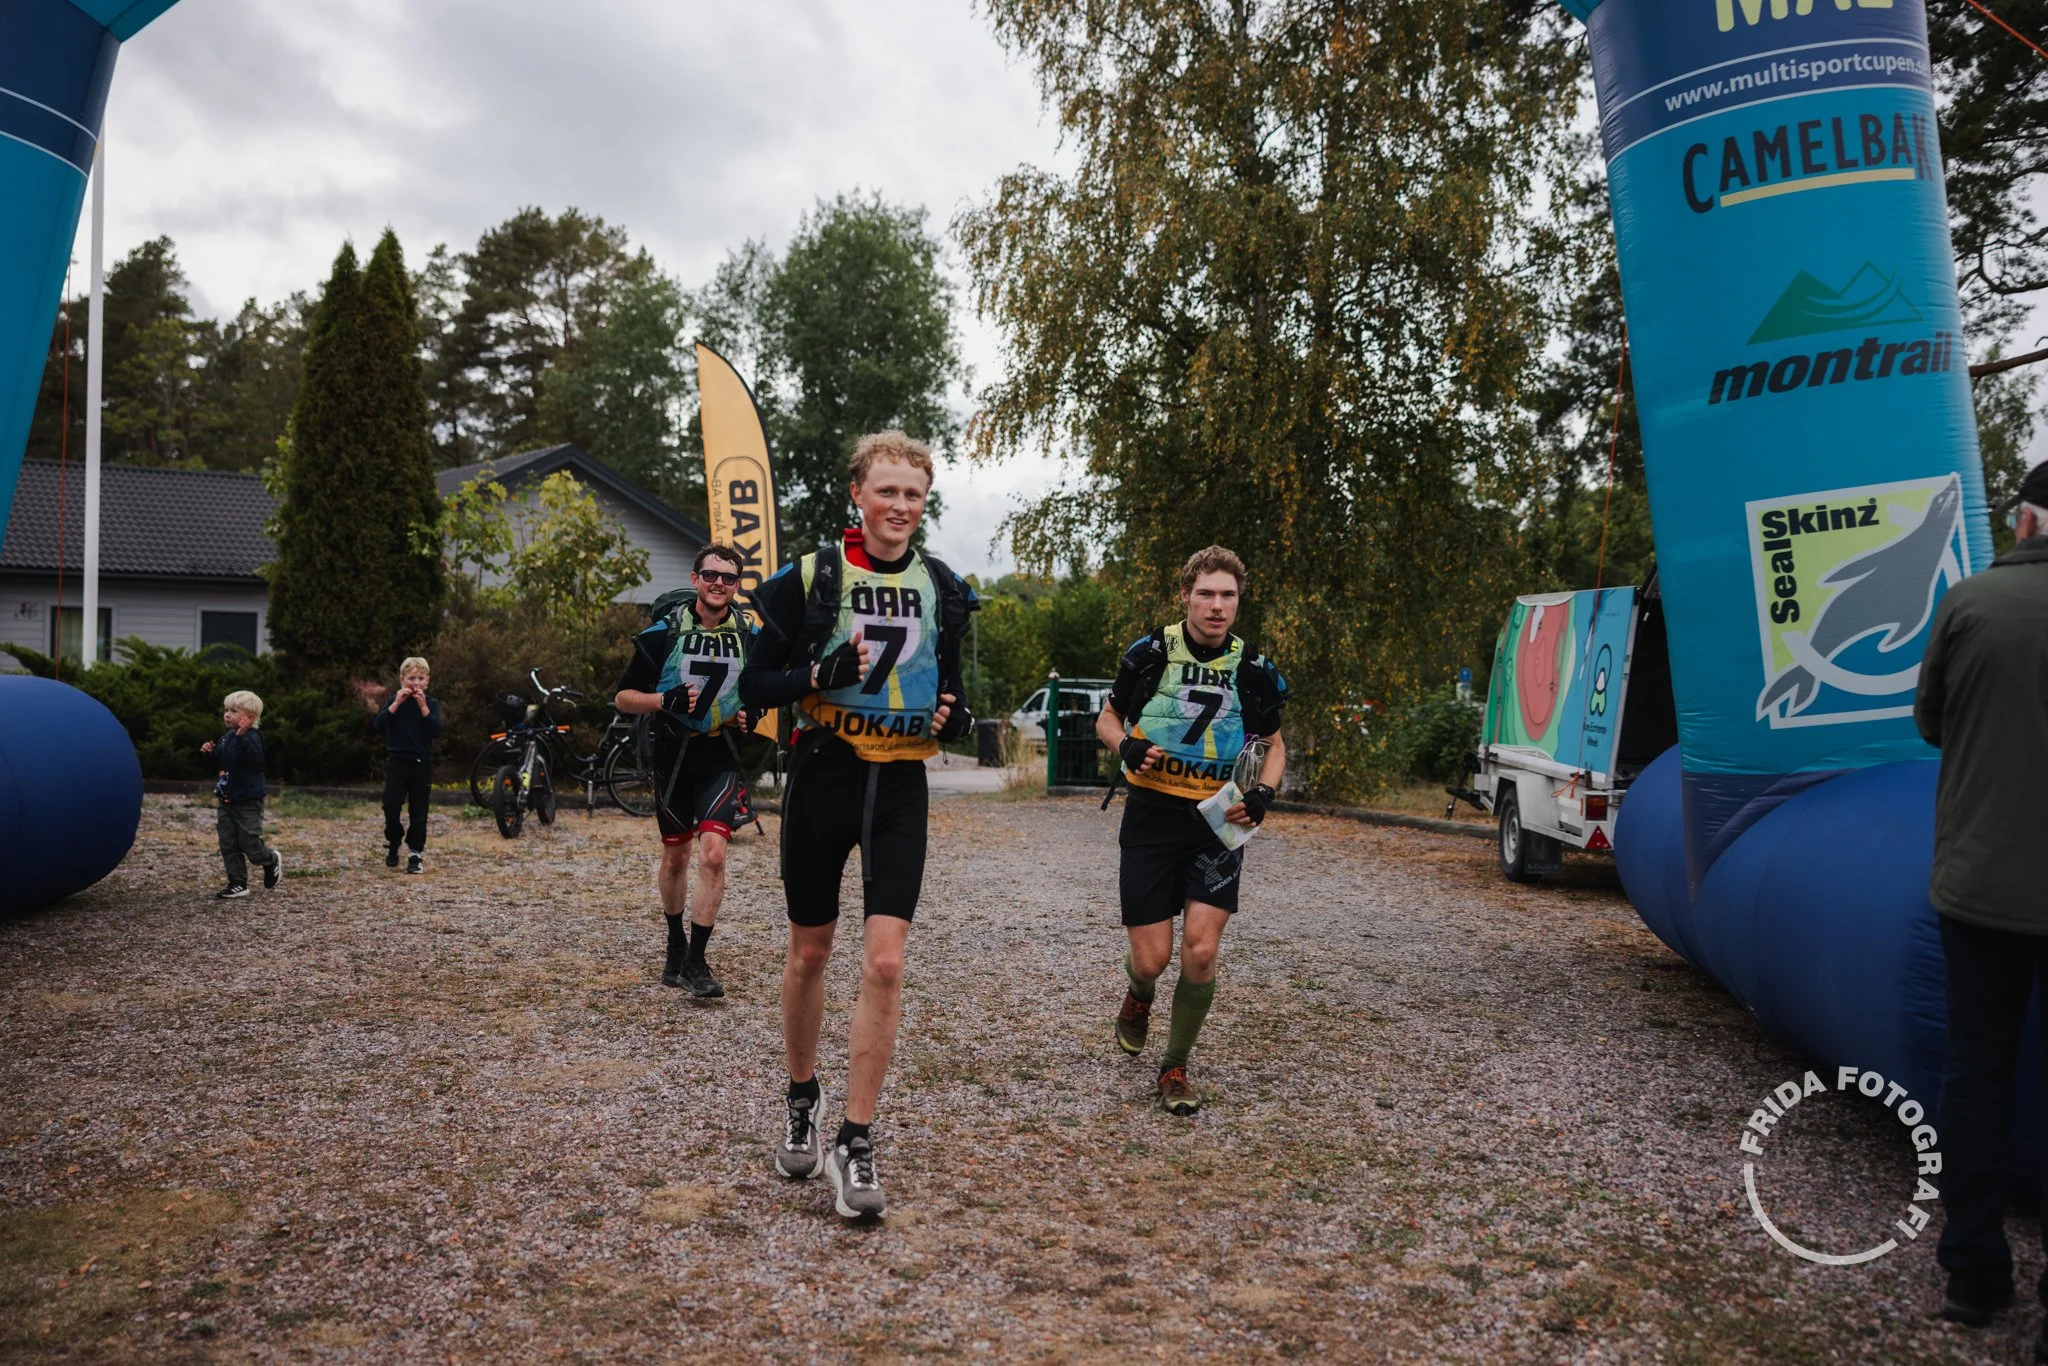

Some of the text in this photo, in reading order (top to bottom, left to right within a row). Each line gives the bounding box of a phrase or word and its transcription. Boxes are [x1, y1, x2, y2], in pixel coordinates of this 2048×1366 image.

[1683, 113, 1933, 214] CAMELBAK
[1708, 332, 1952, 405] montrail
[1762, 504, 1880, 539] Skinz
[1763, 538, 1800, 624] Seal
[687, 661, 729, 721] 7
[860, 624, 908, 695] 7
[825, 711, 925, 737] JOKAB
[1180, 690, 1223, 745] 7
